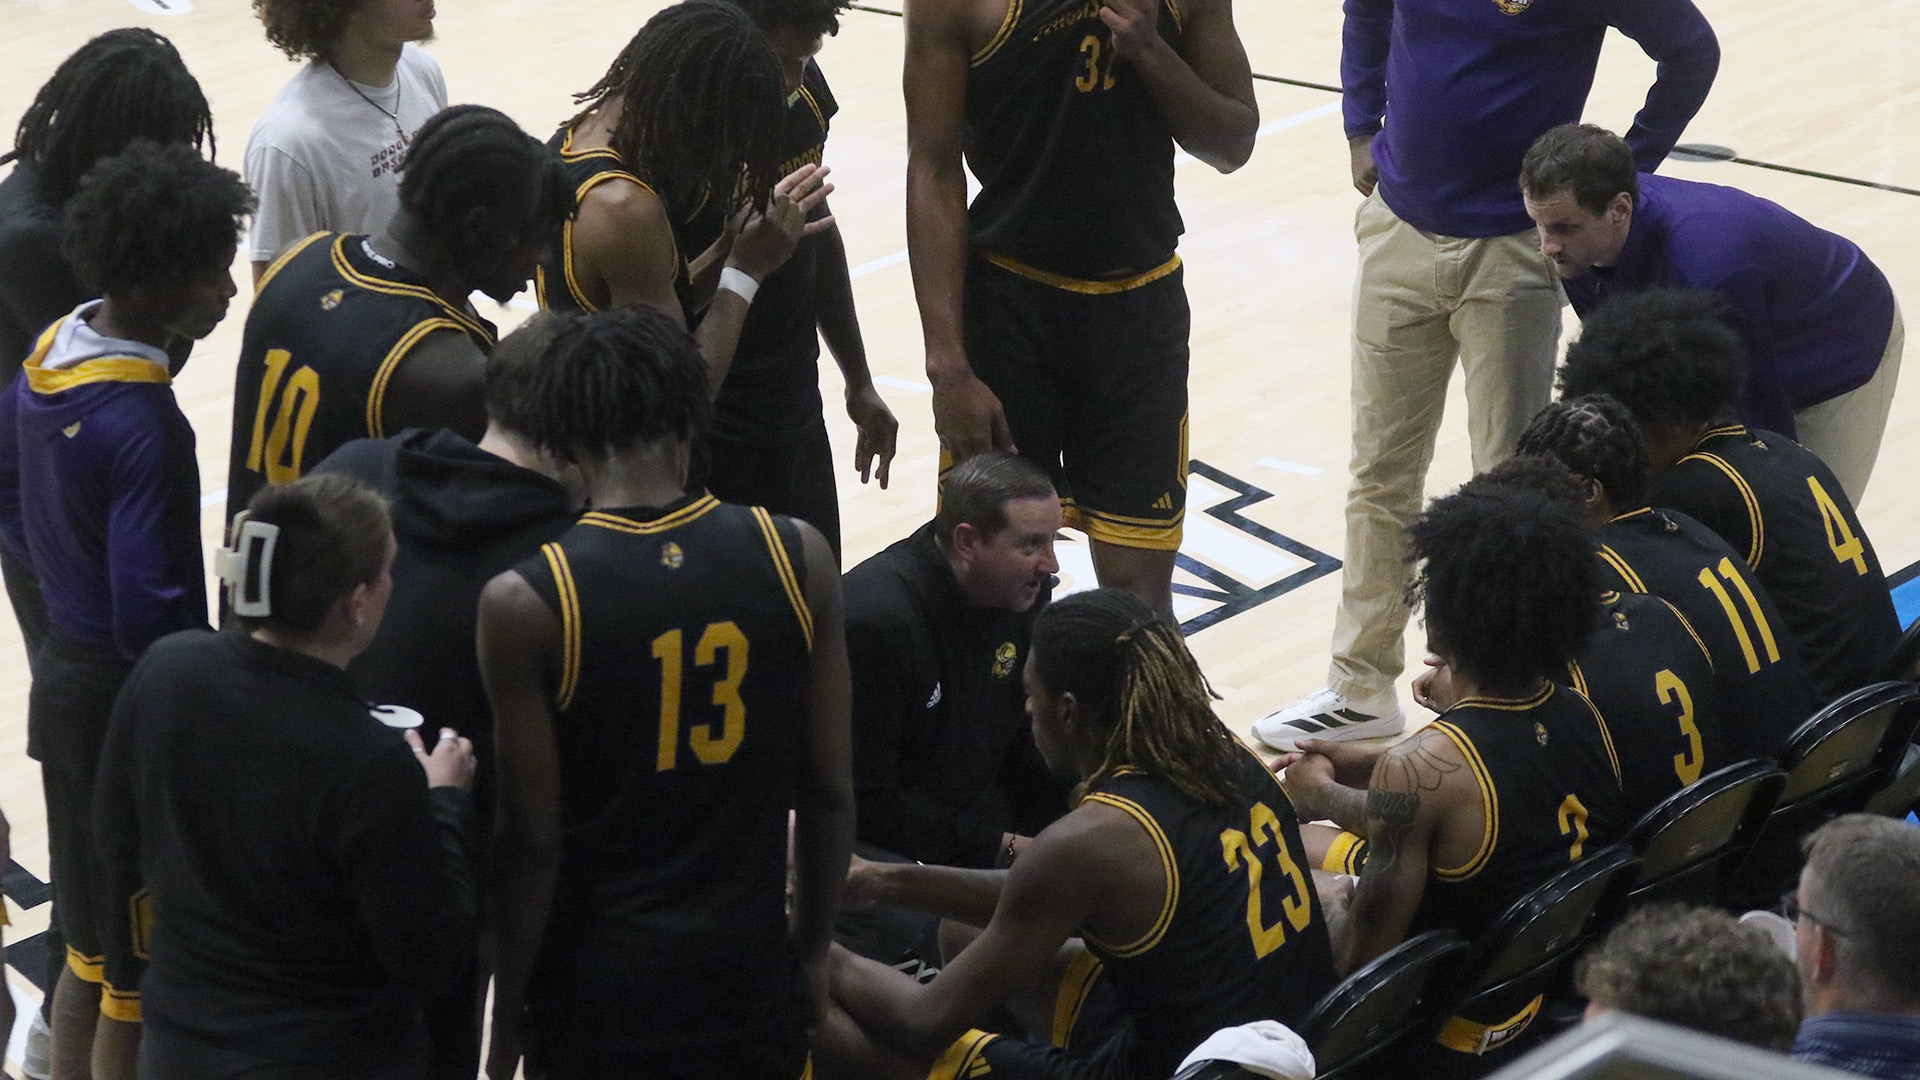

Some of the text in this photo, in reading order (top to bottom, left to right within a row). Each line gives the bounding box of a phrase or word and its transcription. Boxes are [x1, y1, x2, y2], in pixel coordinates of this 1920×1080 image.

[1075, 34, 1117, 93] 3
[245, 348, 321, 486] 10
[1806, 475, 1869, 577] 4
[1697, 556, 1781, 675] 11
[651, 620, 750, 772] 13
[1655, 668, 1705, 788] 3
[1219, 801, 1311, 960] 23
